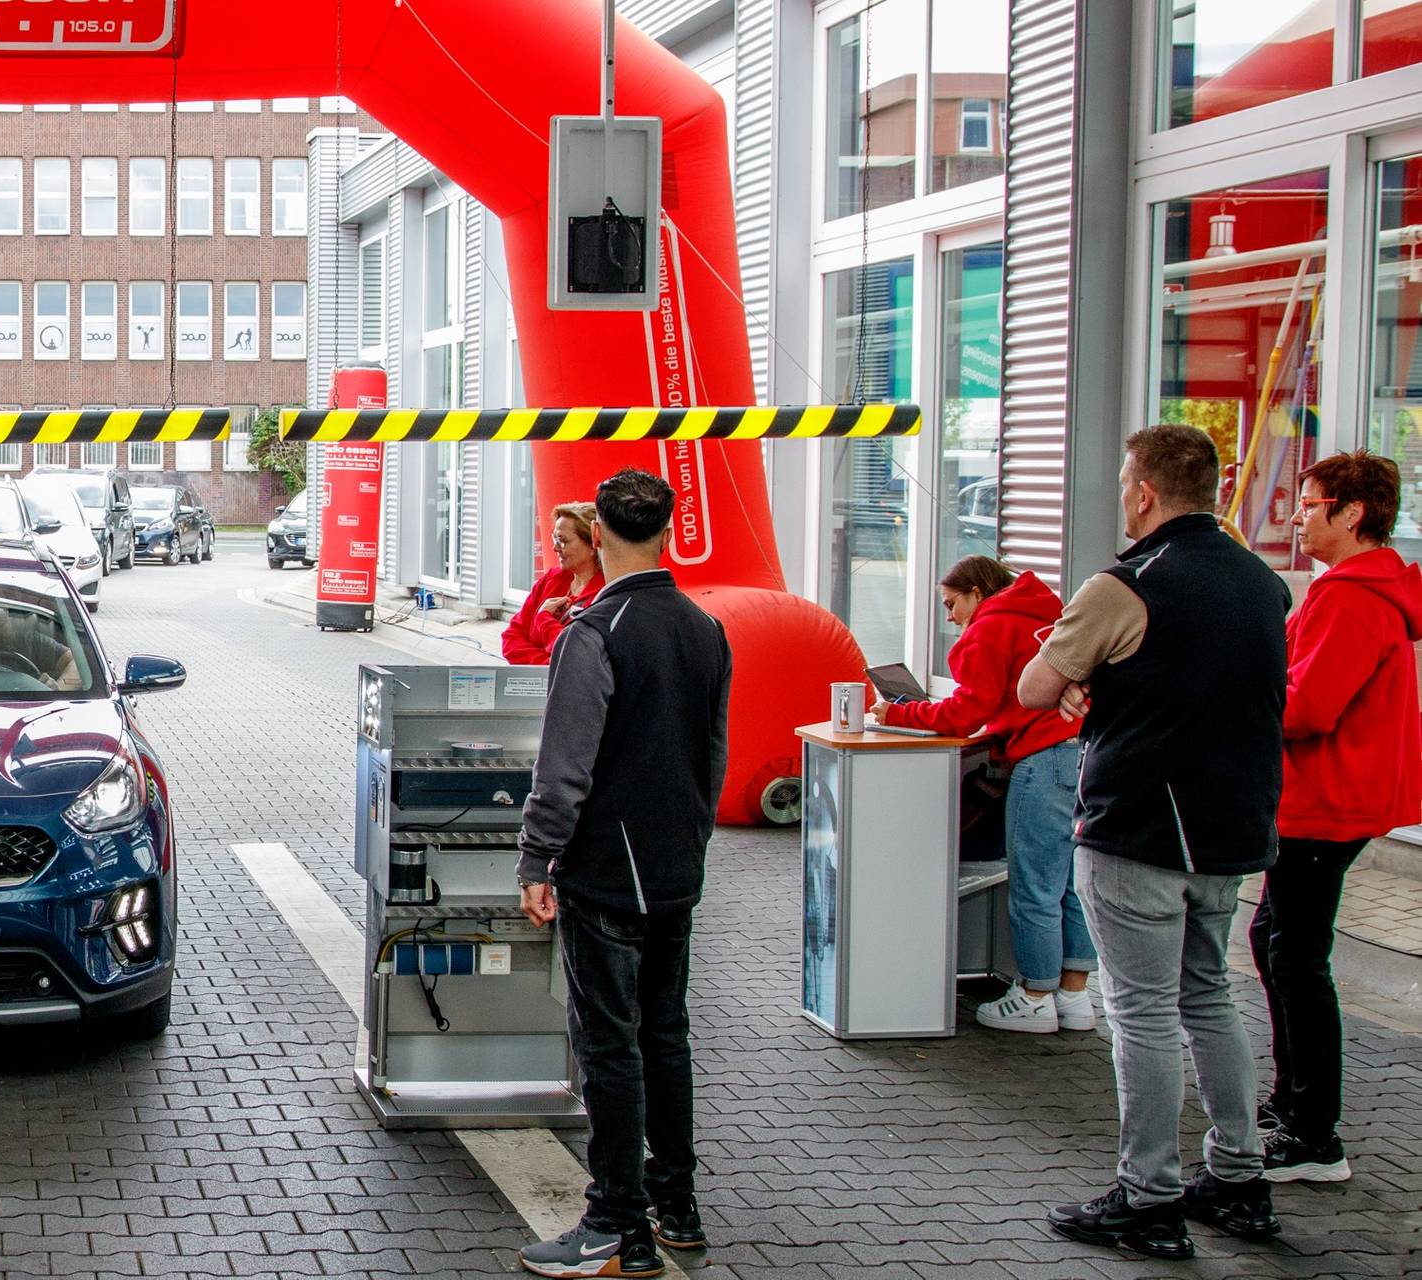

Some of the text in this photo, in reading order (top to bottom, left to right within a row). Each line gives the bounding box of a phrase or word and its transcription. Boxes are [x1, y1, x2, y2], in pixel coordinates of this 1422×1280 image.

[69, 20, 116, 33] 105.0
[660, 297, 676, 343] beste
[664, 346, 679, 370] die
[679, 463, 692, 492] von
[679, 496, 698, 545] 100%
